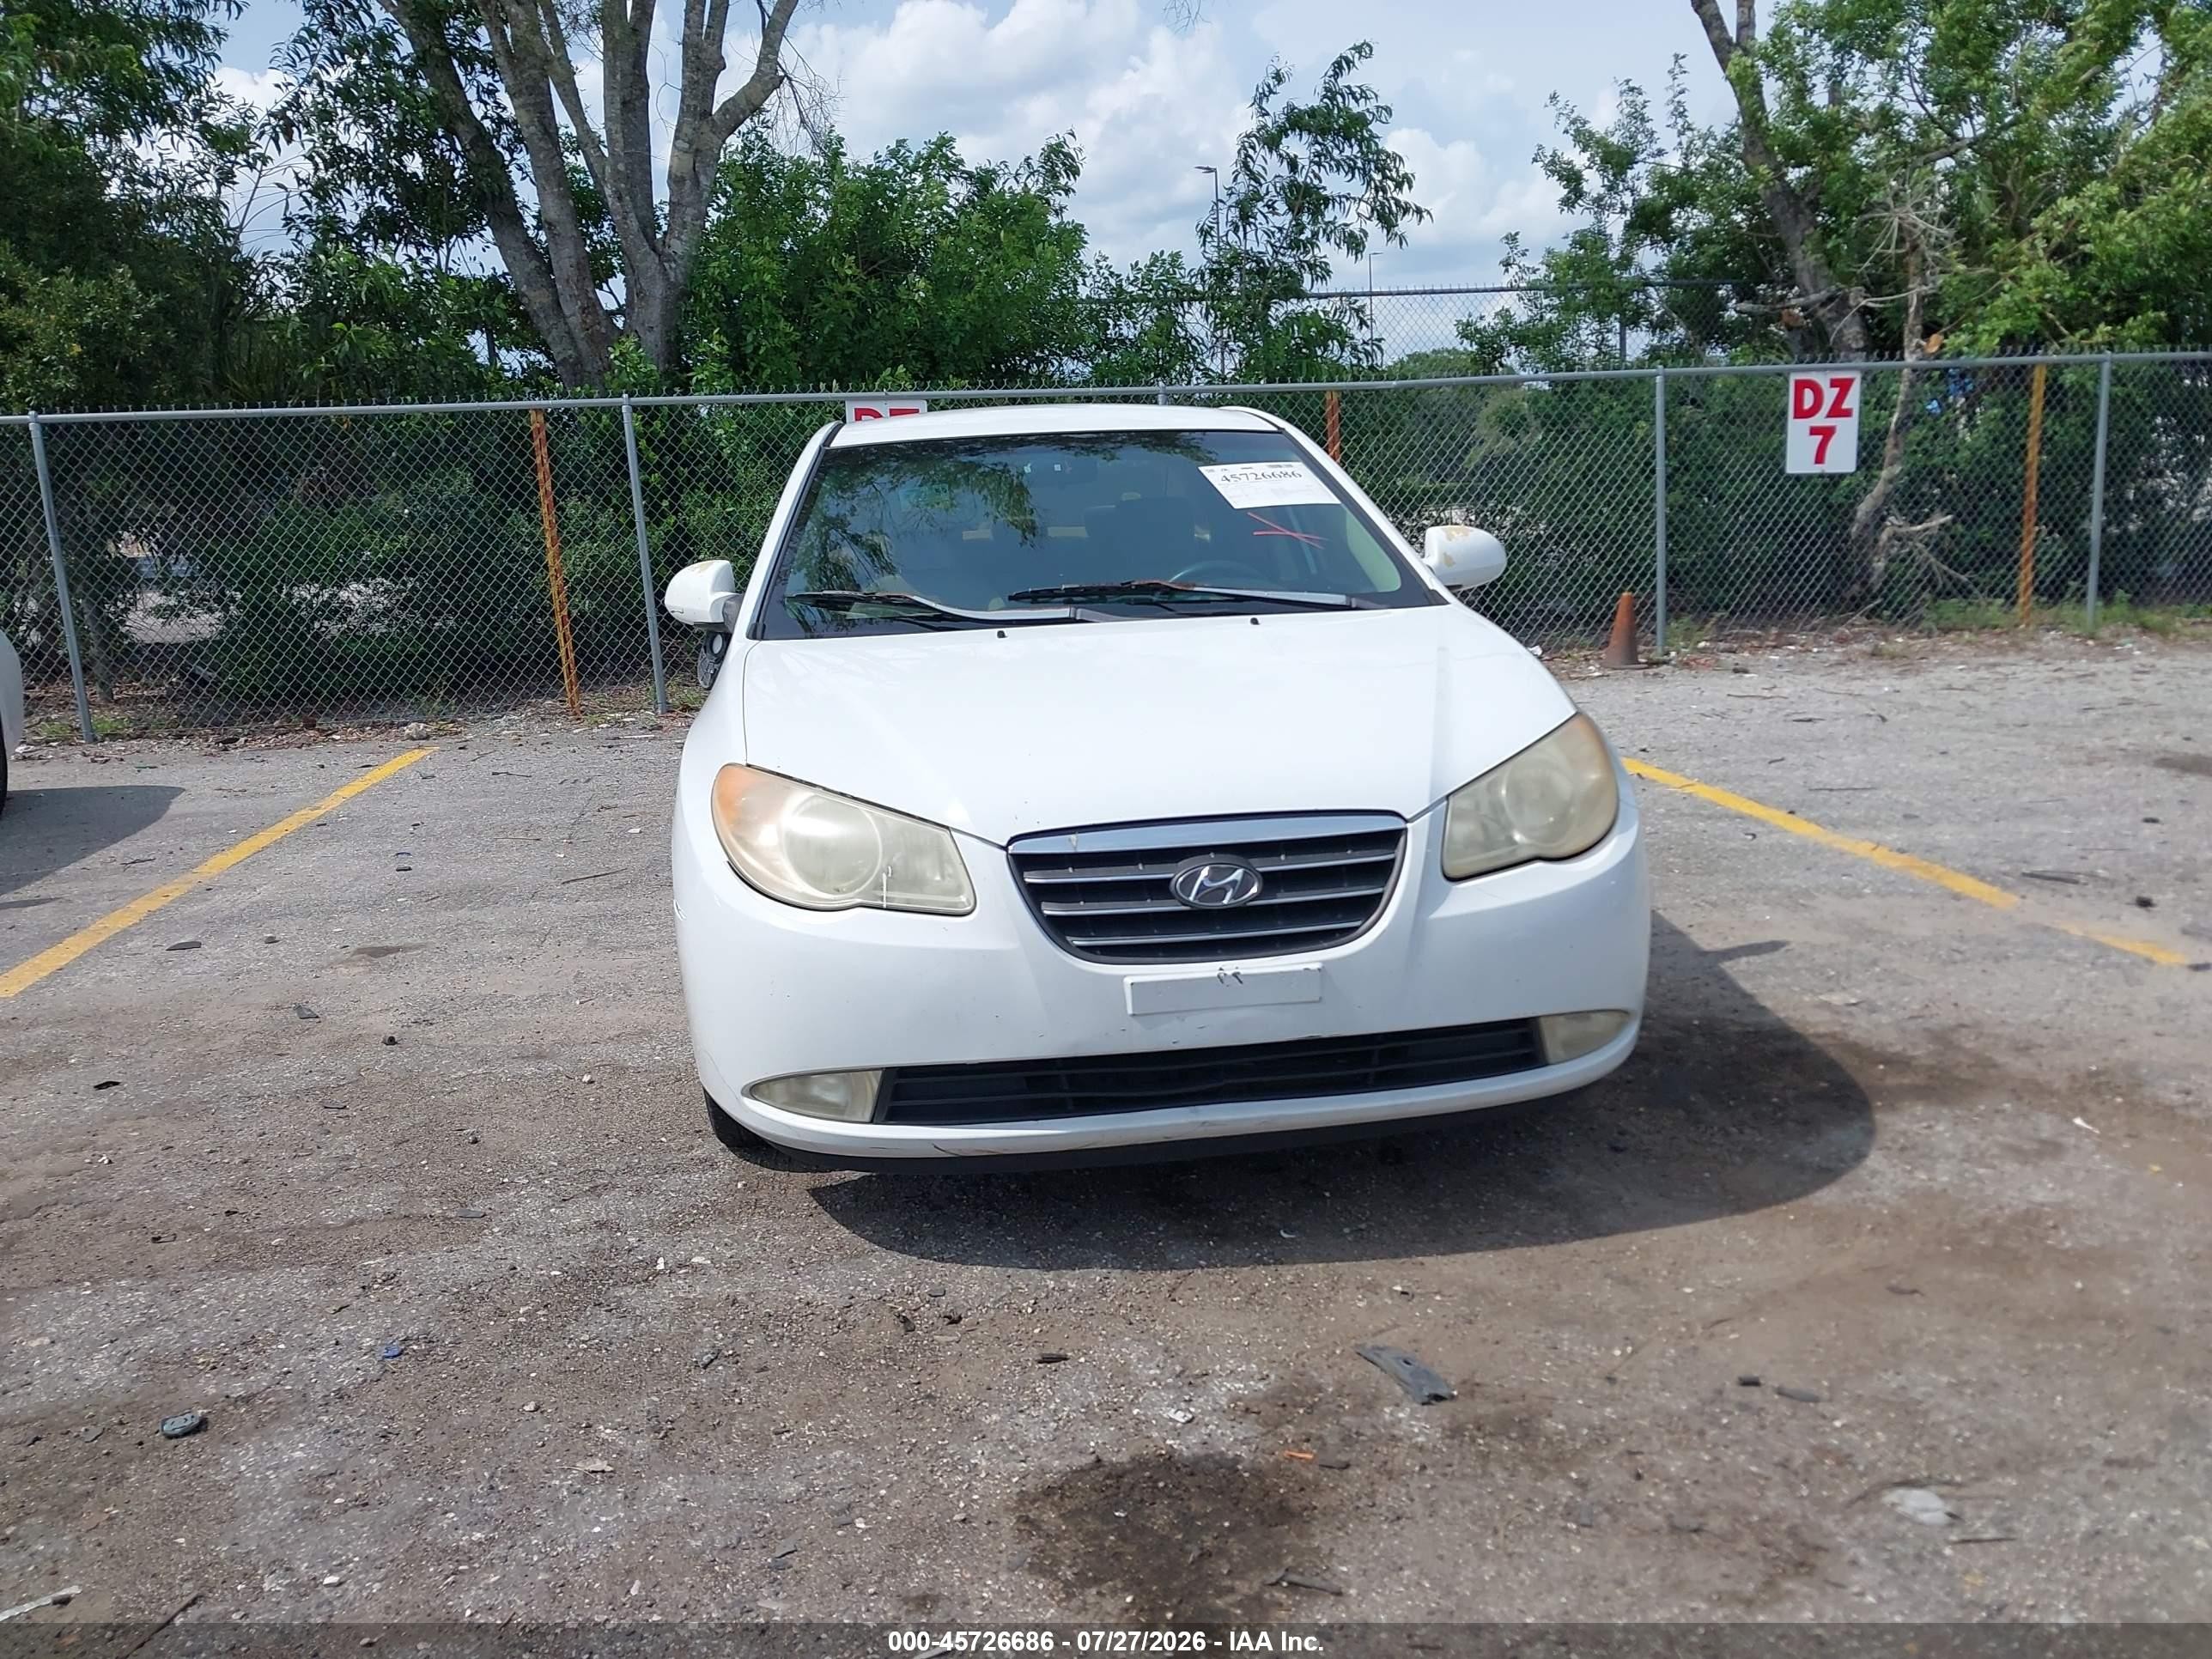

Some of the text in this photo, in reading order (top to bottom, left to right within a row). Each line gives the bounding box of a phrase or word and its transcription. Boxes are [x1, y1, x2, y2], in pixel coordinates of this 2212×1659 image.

[1793, 378, 1855, 419] DZ
[1809, 425, 1837, 465] 7
[1221, 471, 1302, 483] 45726686
